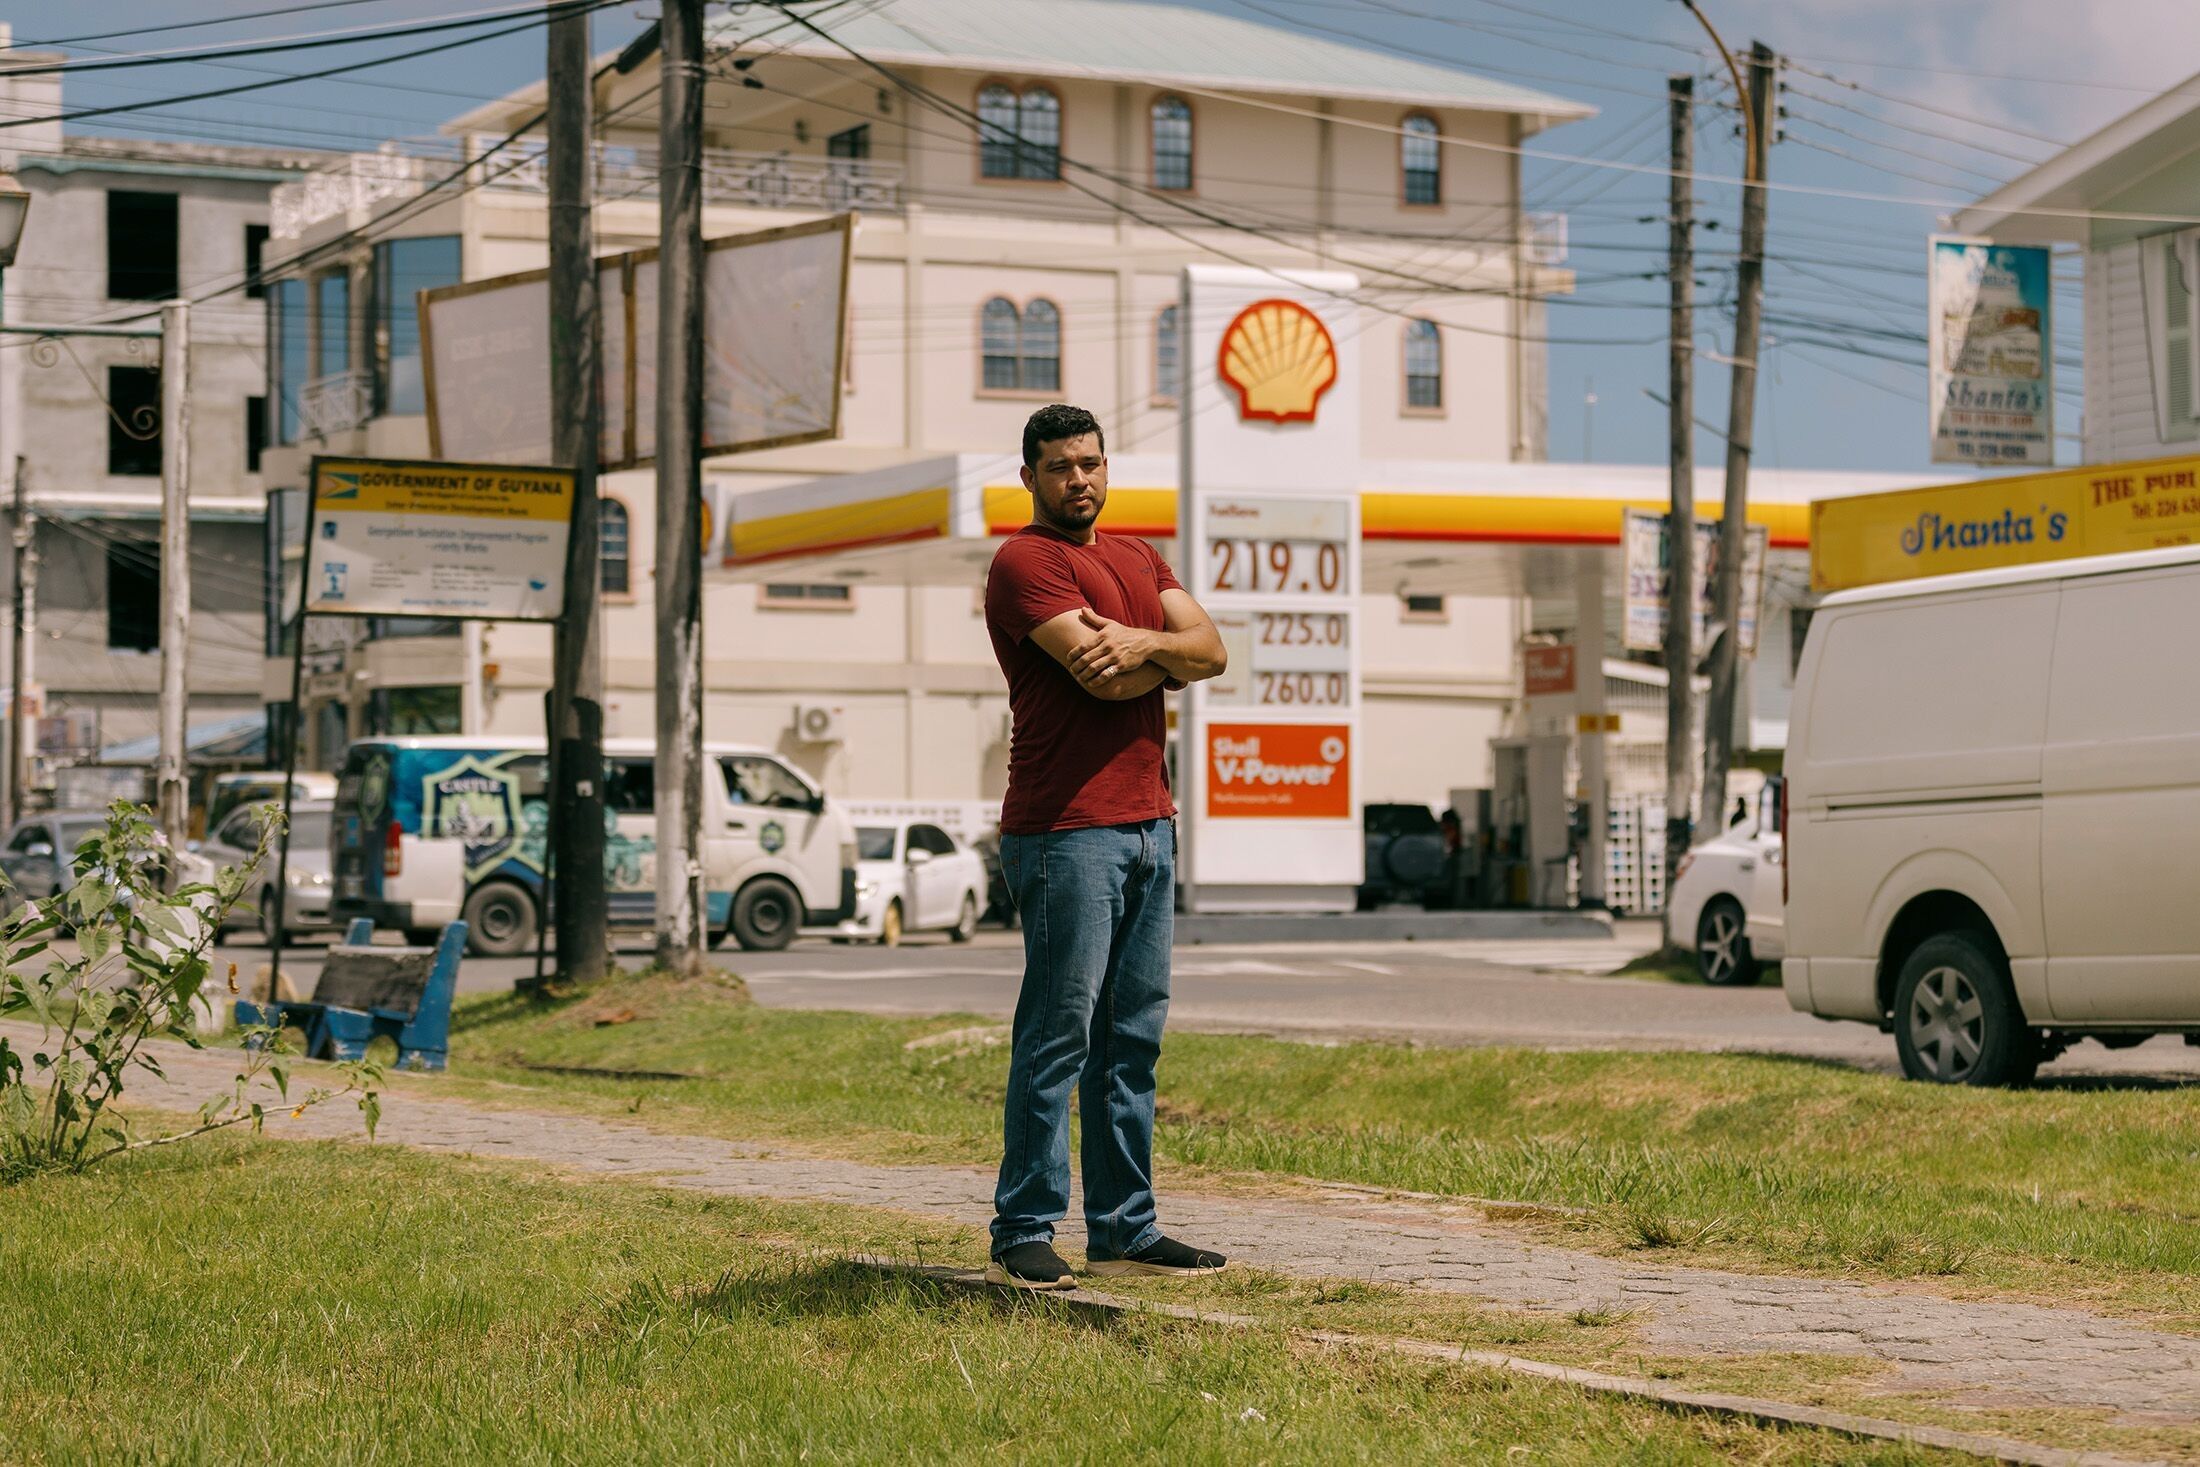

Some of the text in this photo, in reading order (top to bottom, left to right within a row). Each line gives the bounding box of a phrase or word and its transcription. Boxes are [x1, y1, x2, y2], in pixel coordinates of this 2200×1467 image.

[361, 473, 562, 495] GOVERNMENT OF GUYANA
[2090, 476, 2135, 508] THE
[1902, 504, 2068, 555] Shanta's
[1212, 539, 1338, 591] 219.0
[1260, 614, 1342, 645] 225.0
[1260, 672, 1342, 704] 260.0
[1213, 737, 1260, 756] Shell
[1213, 758, 1335, 785] V-Power
